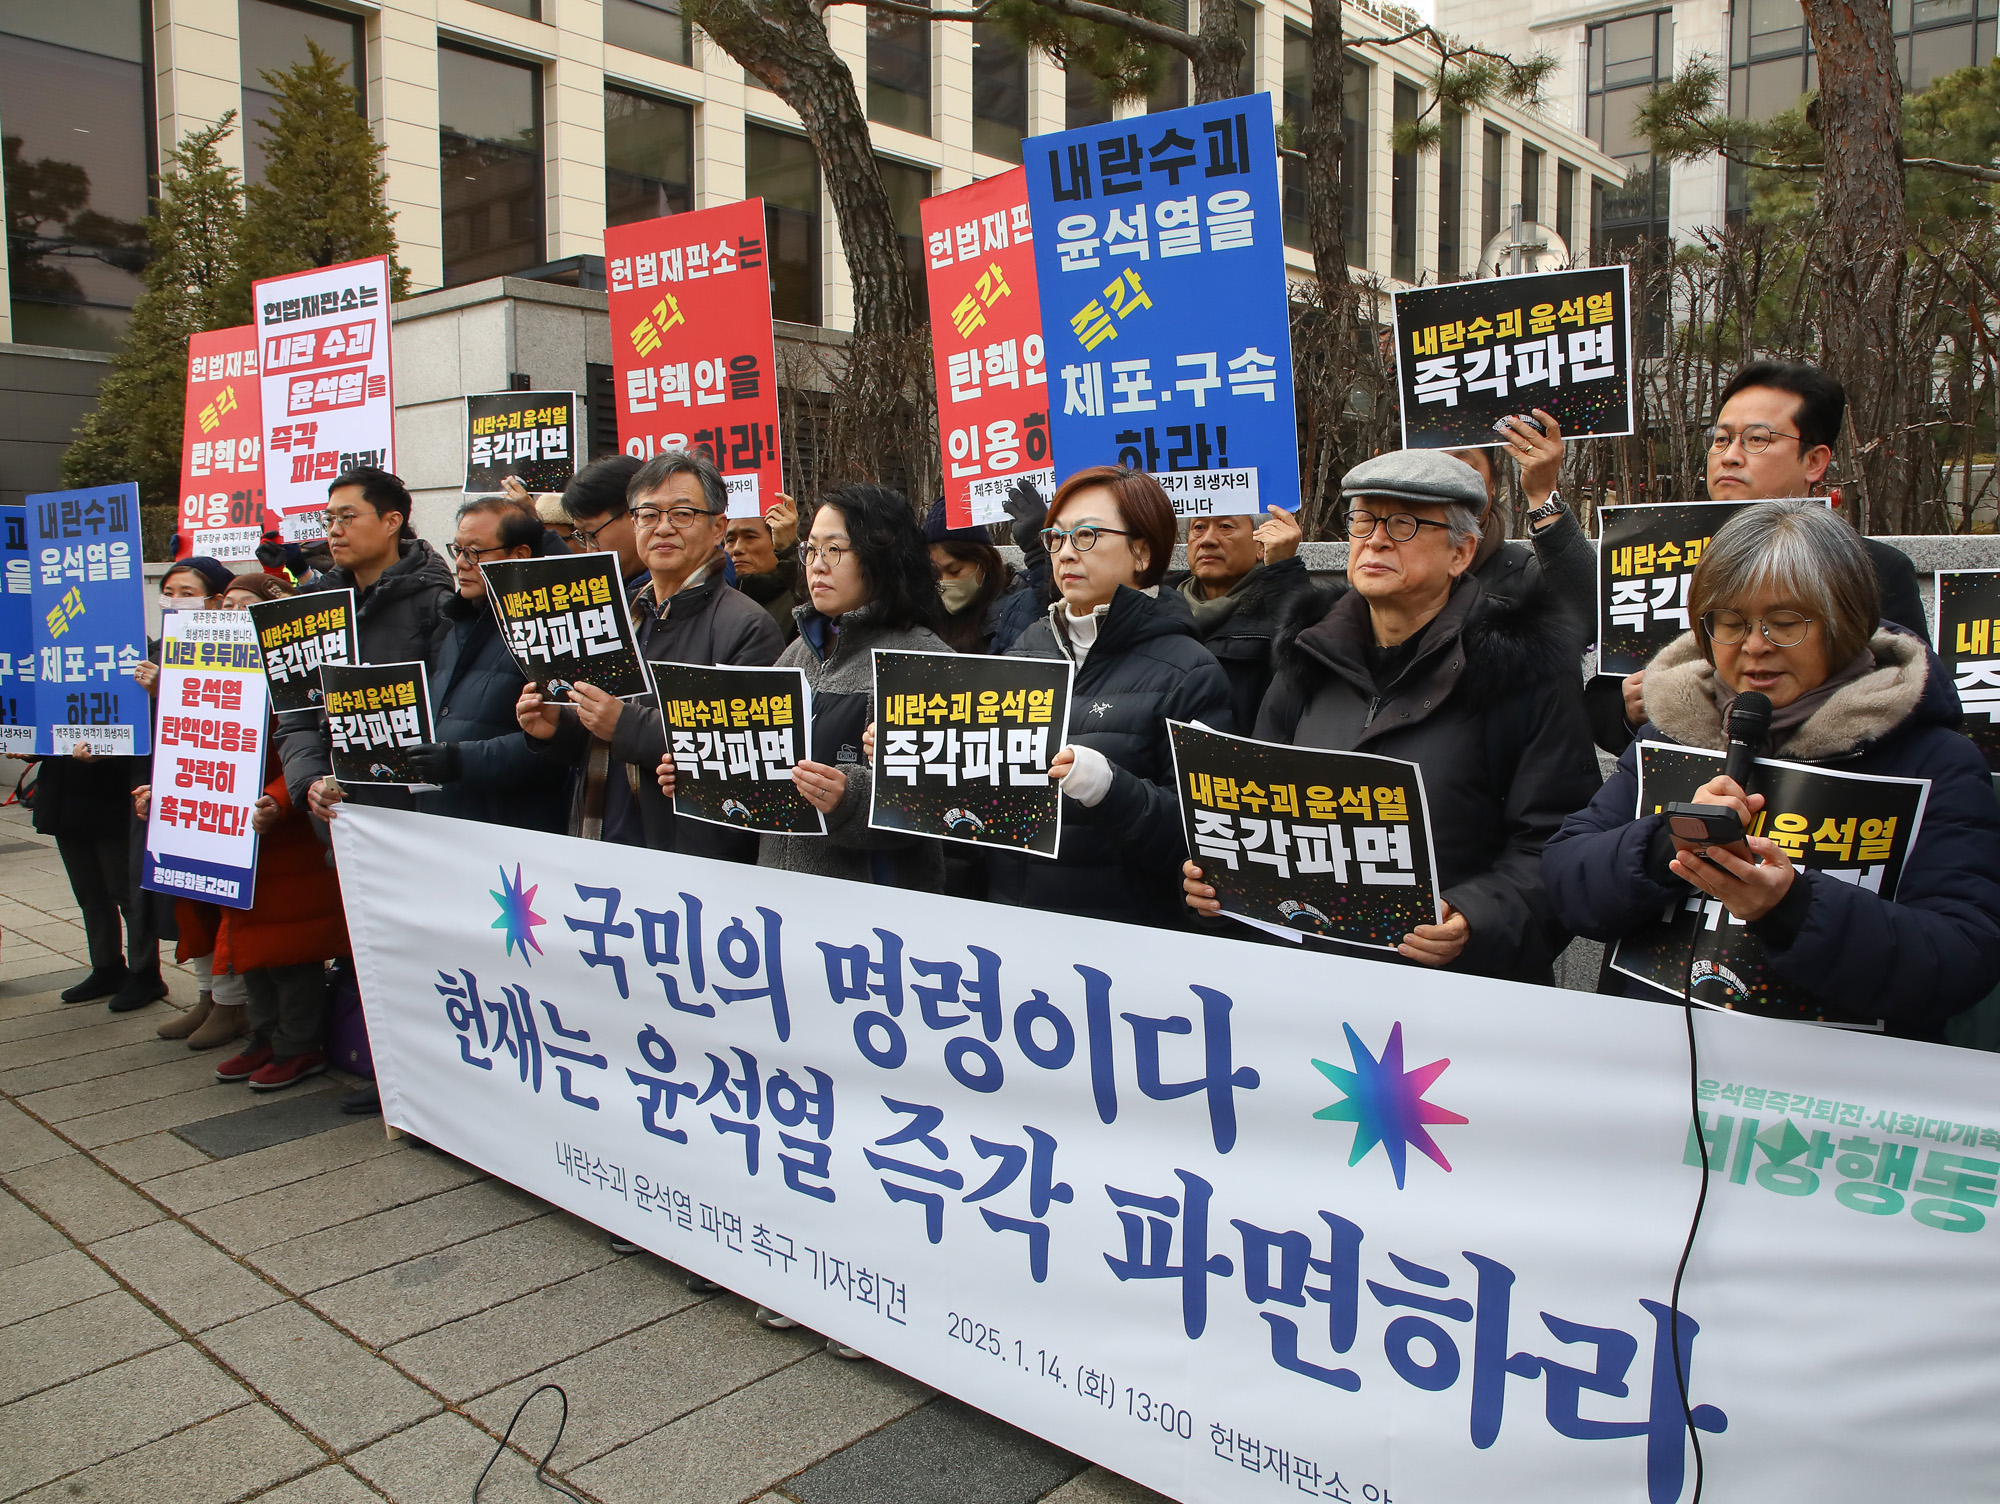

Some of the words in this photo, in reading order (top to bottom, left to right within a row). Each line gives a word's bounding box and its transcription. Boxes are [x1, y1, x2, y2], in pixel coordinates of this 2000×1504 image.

[1048, 113, 1250, 203] 내란수괴
[928, 202, 1034, 270] 헌법재판
[1056, 189, 1255, 272] 윤석열을
[610, 236, 762, 293] 헌법재판소는
[263, 285, 378, 326] 헌법재판소는
[950, 262, 1012, 340] 즉각
[1070, 267, 1153, 352] 즉각
[630, 292, 685, 358] 즉각
[1412, 308, 1523, 356] 내란수괴
[1528, 291, 1614, 335] 윤석열
[191, 349, 258, 383] 헌법재판
[266, 333, 316, 370] 내란
[321, 323, 373, 359] 수괴
[1413, 324, 1615, 408] 즉각파면
[626, 355, 760, 414] 탄핵안을
[948, 333, 1047, 404] 탄핵안
[198, 385, 238, 435] 즉각
[472, 411, 521, 436] 내란수괴
[523, 406, 568, 429] 윤석열
[191, 436, 261, 476] 탄핵안
[270, 421, 318, 453] 즉각
[471, 426, 568, 468] 즉각파면
[948, 410, 1053, 479] 인용하
[290, 448, 386, 484] 파면하라!
[726, 478, 753, 494] 생자의
[974, 478, 1013, 497] 제주항공
[1157, 475, 1188, 492] 객기
[1193, 472, 1249, 491] 희생자의
[38, 494, 129, 539] 내란수괴
[300, 510, 327, 524] 제주항
[1172, 497, 1213, 515] 빕니다
[195, 532, 221, 544] 제주항공
[222, 531, 242, 542] 여객기
[243, 530, 262, 541] 희생자
[232, 546, 251, 556] 빕니다
[293, 526, 323, 541] 희생자의
[41, 541, 131, 585] 윤석열을
[1611, 537, 1711, 576] 내란수괴
[46, 586, 86, 639] 즉각
[193, 612, 218, 624] 제주항공
[219, 612, 239, 624] 여객기
[502, 587, 551, 618] 내란수괴
[551, 575, 613, 612] 윤석열
[1609, 573, 1692, 633] 즉각
[185, 629, 211, 640] 희생자의
[233, 630, 253, 642] 빕니다
[261, 618, 304, 649] 내란수괴
[304, 606, 346, 634] 윤석열
[510, 604, 623, 665] 즉각파면
[165, 641, 196, 665] 내란
[266, 629, 348, 684] 즉각파면
[66, 692, 118, 725] 하라!
[182, 677, 242, 711] 윤석열
[326, 688, 367, 714] 내란수괴
[367, 681, 417, 710] 윤석열
[666, 699, 729, 728] 내란수괴
[730, 693, 793, 727] 윤석열
[885, 691, 972, 727] 내란수괴
[976, 689, 1054, 724] 윤석열
[0, 728, 32, 739] 생자의
[55, 728, 81, 739] 제주항공
[83, 727, 103, 739] 여객기
[104, 727, 130, 739] 희생자의
[94, 743, 114, 755] 빕니다
[161, 715, 258, 753] 탄핵인용을
[328, 706, 423, 753] 즉각파면
[175, 757, 236, 793] 강력히
[672, 726, 795, 781] 즉각파면
[883, 726, 1050, 787] 즉각파면
[160, 796, 249, 837] 촉구한다!
[1188, 772, 1300, 818] 내란수괴
[1305, 785, 1409, 821] 윤석열
[1194, 808, 1416, 886] 즉각파면
[1768, 812, 1898, 861] 윤석열
[563, 882, 791, 1042] 국민의
[815, 927, 1260, 1154] 명령이다
[434, 967, 608, 1111] 헌재는
[625, 1023, 836, 1203] 윤석열
[862, 1095, 1074, 1283] 즉각
[1102, 1167, 1728, 1504] 파면하라
[555, 1141, 628, 1201] 내란수괴
[634, 1174, 693, 1231] 윤석열
[699, 1202, 743, 1253] 파면
[751, 1223, 797, 1273] 촉구
[804, 1246, 906, 1326] 기자회견
[1077, 1364, 1116, 1410] (화)
[1125, 1387, 1193, 1440] 13:00
[1209, 1422, 1352, 1504] 헌법재판소
